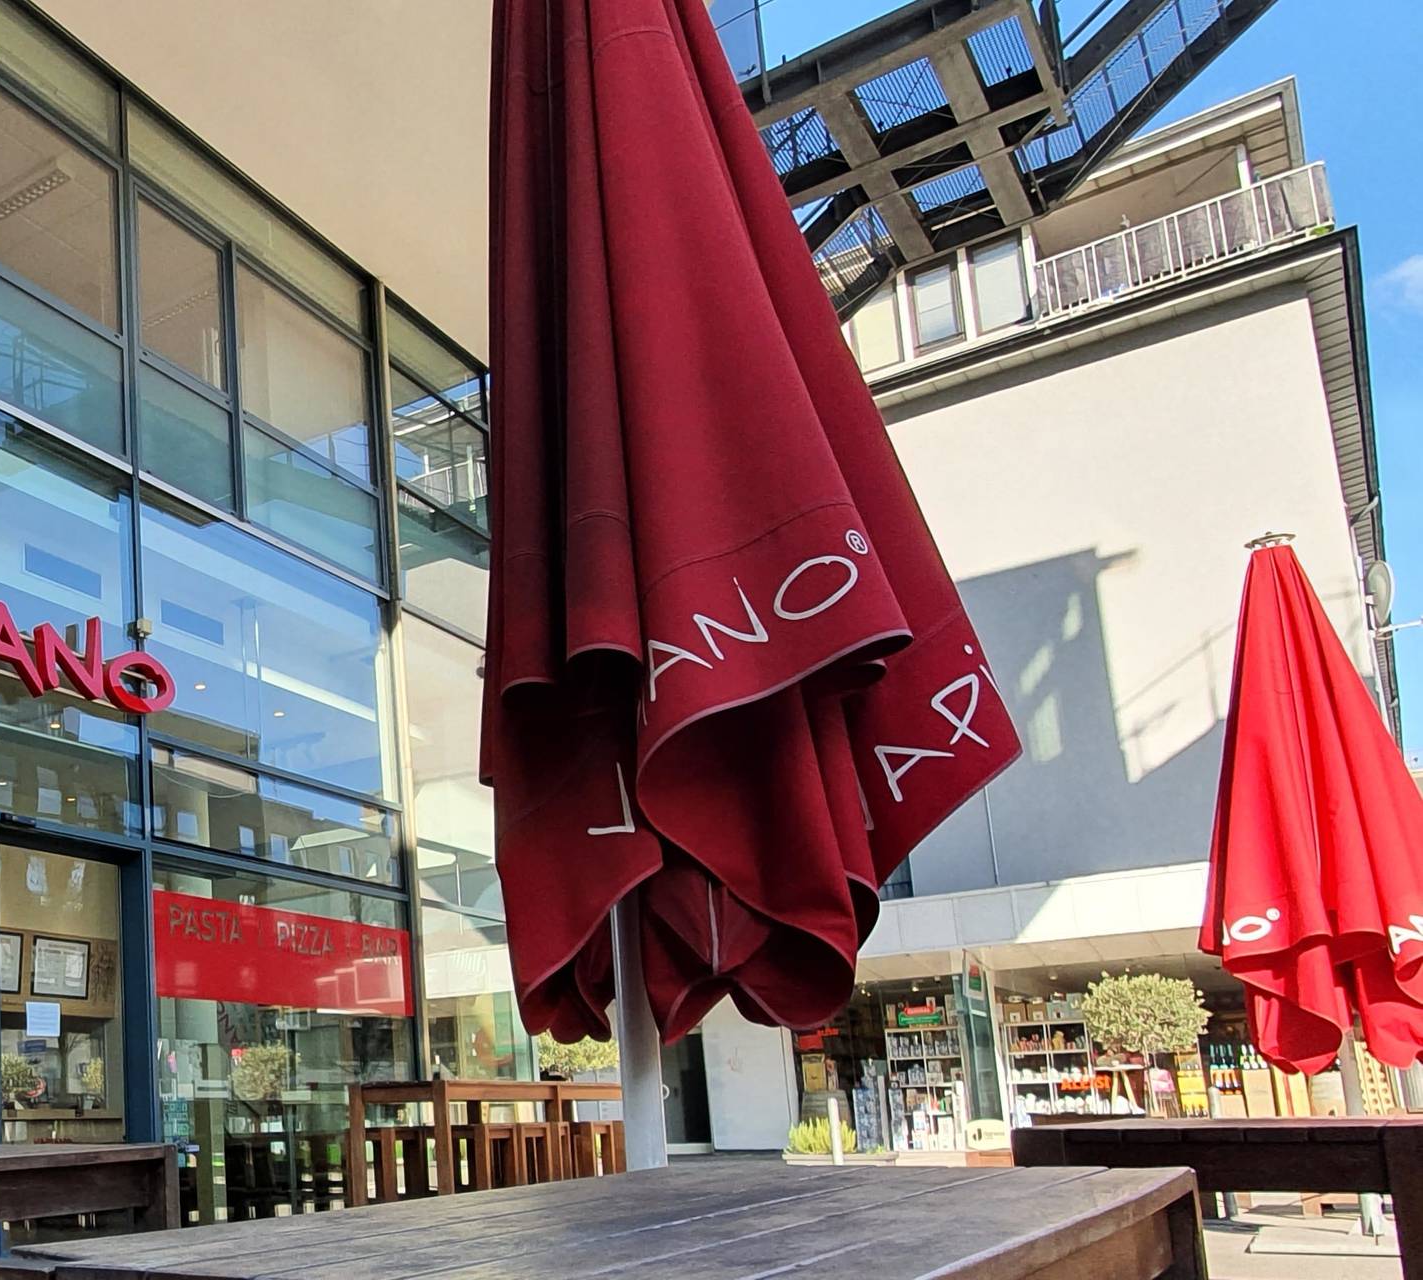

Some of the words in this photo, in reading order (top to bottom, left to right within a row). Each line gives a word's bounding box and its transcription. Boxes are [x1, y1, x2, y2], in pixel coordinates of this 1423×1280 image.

[169, 904, 242, 944] PASTA
[277, 921, 335, 956] PIZZA
[361, 934, 401, 967] BAR
